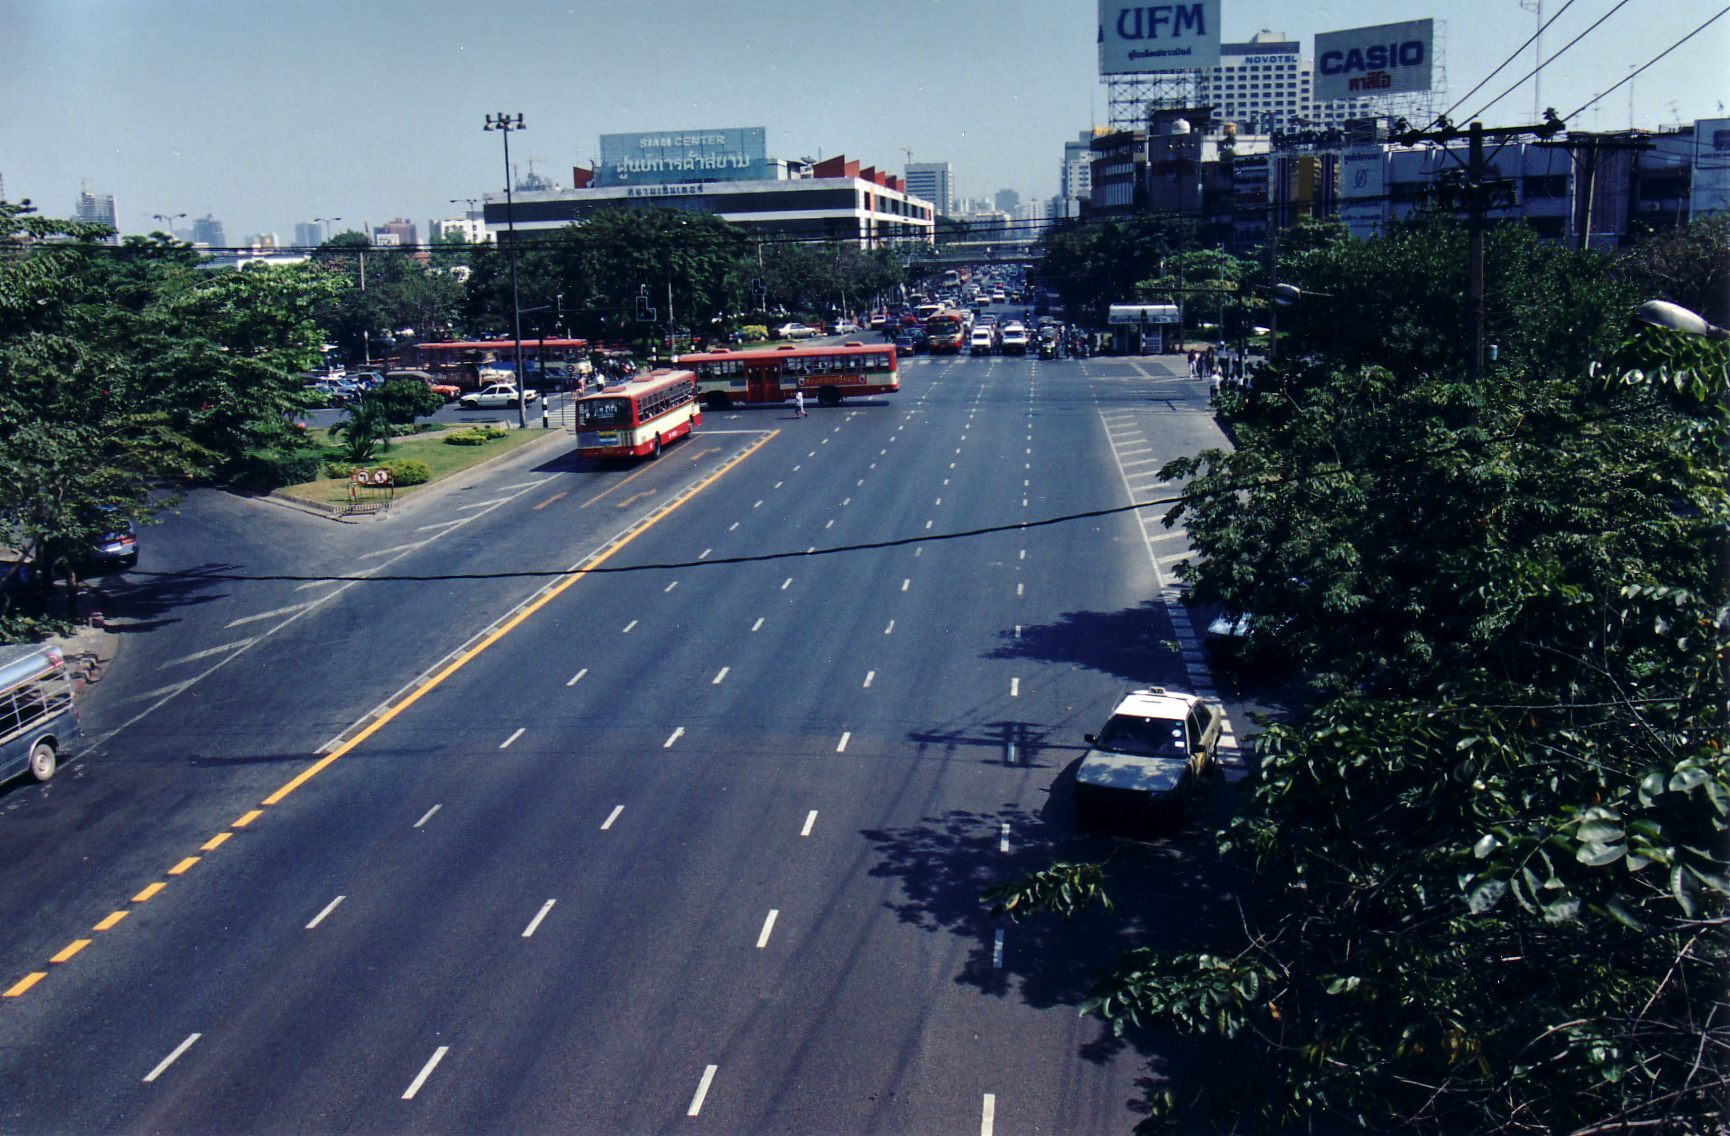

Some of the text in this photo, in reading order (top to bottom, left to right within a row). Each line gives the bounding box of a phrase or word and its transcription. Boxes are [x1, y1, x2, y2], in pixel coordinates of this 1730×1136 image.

[1117, 3, 1206, 40] UFM
[1245, 55, 1298, 64] NOVOTEL
[1320, 40, 1424, 75] CASIO
[640, 134, 725, 148] SIAM CENTER
[616, 150, 750, 180] ศูนย์การค้าสยาม
